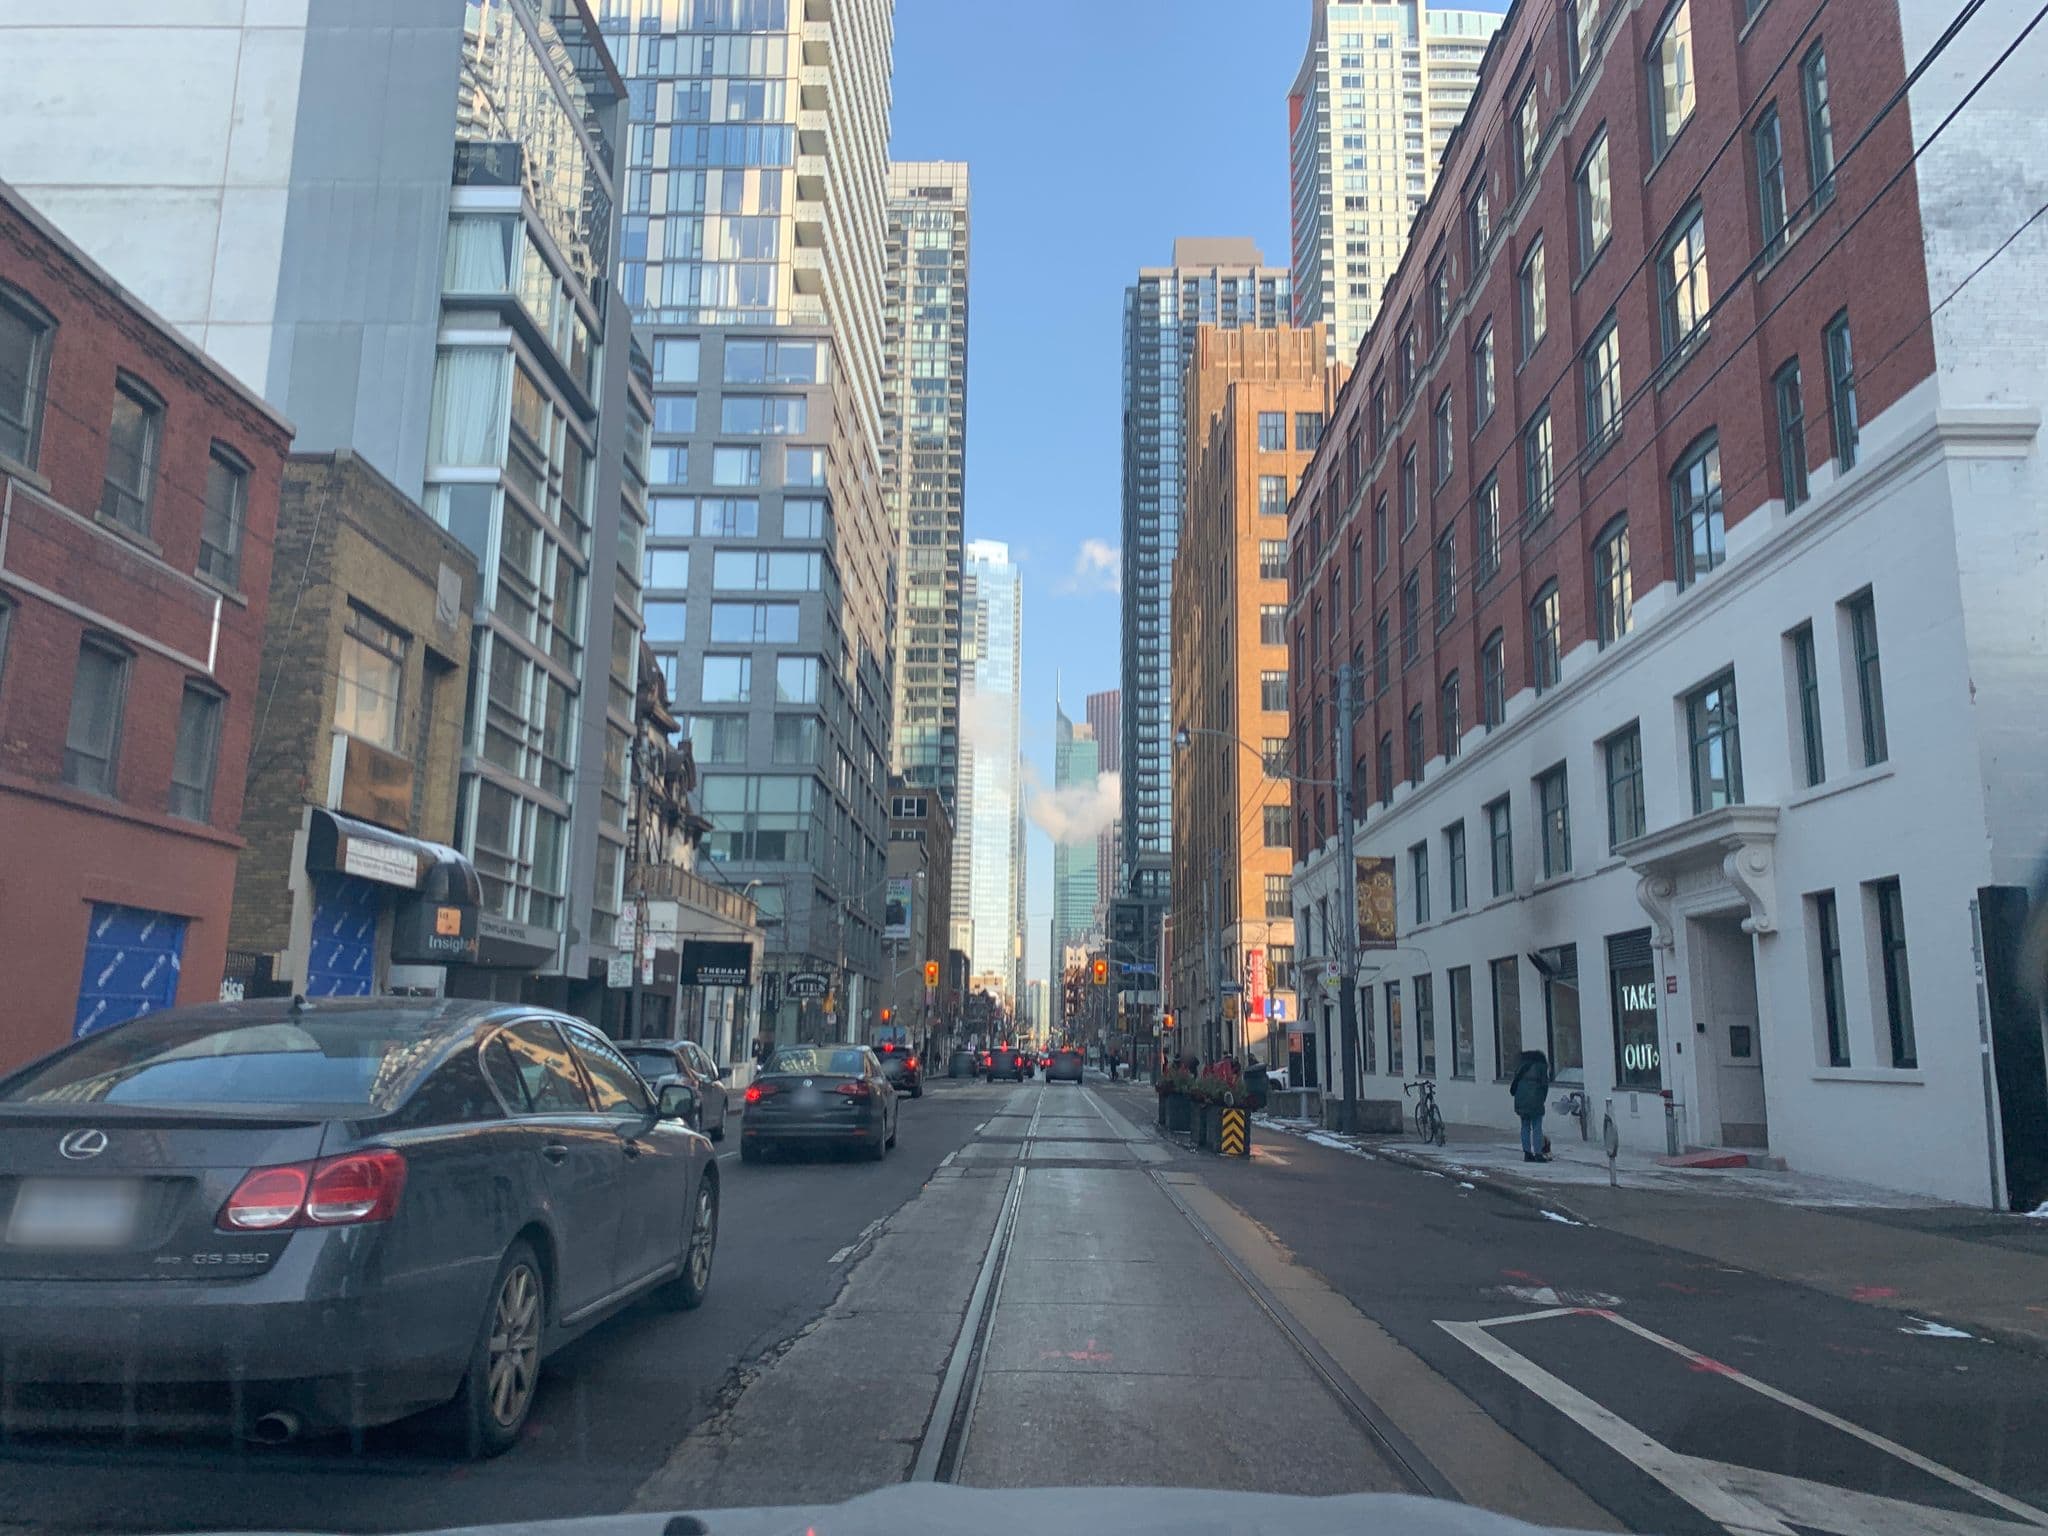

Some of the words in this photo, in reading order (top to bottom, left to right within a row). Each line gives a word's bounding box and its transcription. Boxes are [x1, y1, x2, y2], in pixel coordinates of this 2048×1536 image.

[1622, 983, 1656, 1011] TAKE
[1625, 1044, 1653, 1070] OUT
[192, 1254, 223, 1264] GS
